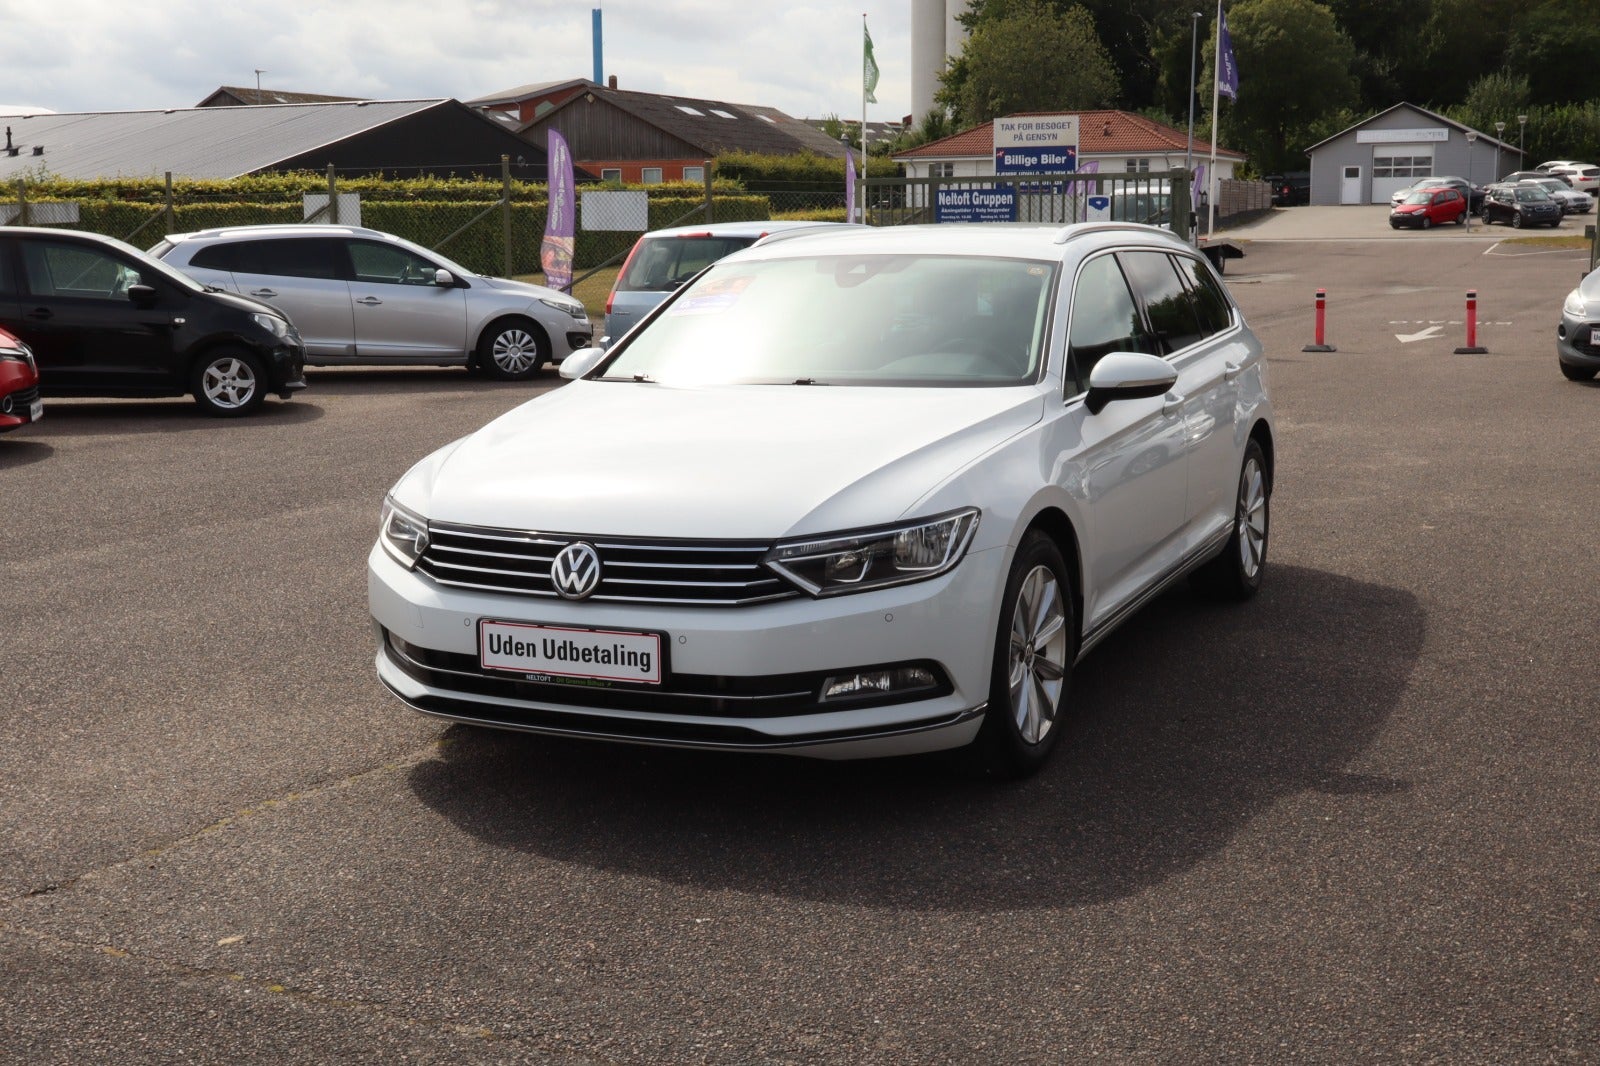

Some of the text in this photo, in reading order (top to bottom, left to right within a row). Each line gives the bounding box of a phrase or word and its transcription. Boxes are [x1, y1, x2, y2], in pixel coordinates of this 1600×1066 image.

[1035, 122, 1071, 130] BESØGET
[1013, 133, 1058, 141] PÅ GENSYN
[1004, 154, 1067, 167] Billige Biler
[938, 192, 1013, 207] Neltoft Gruppen
[552, 543, 599, 597] VW
[488, 633, 651, 673] Uden Udbetaling
[526, 674, 551, 682] NELTOFT
